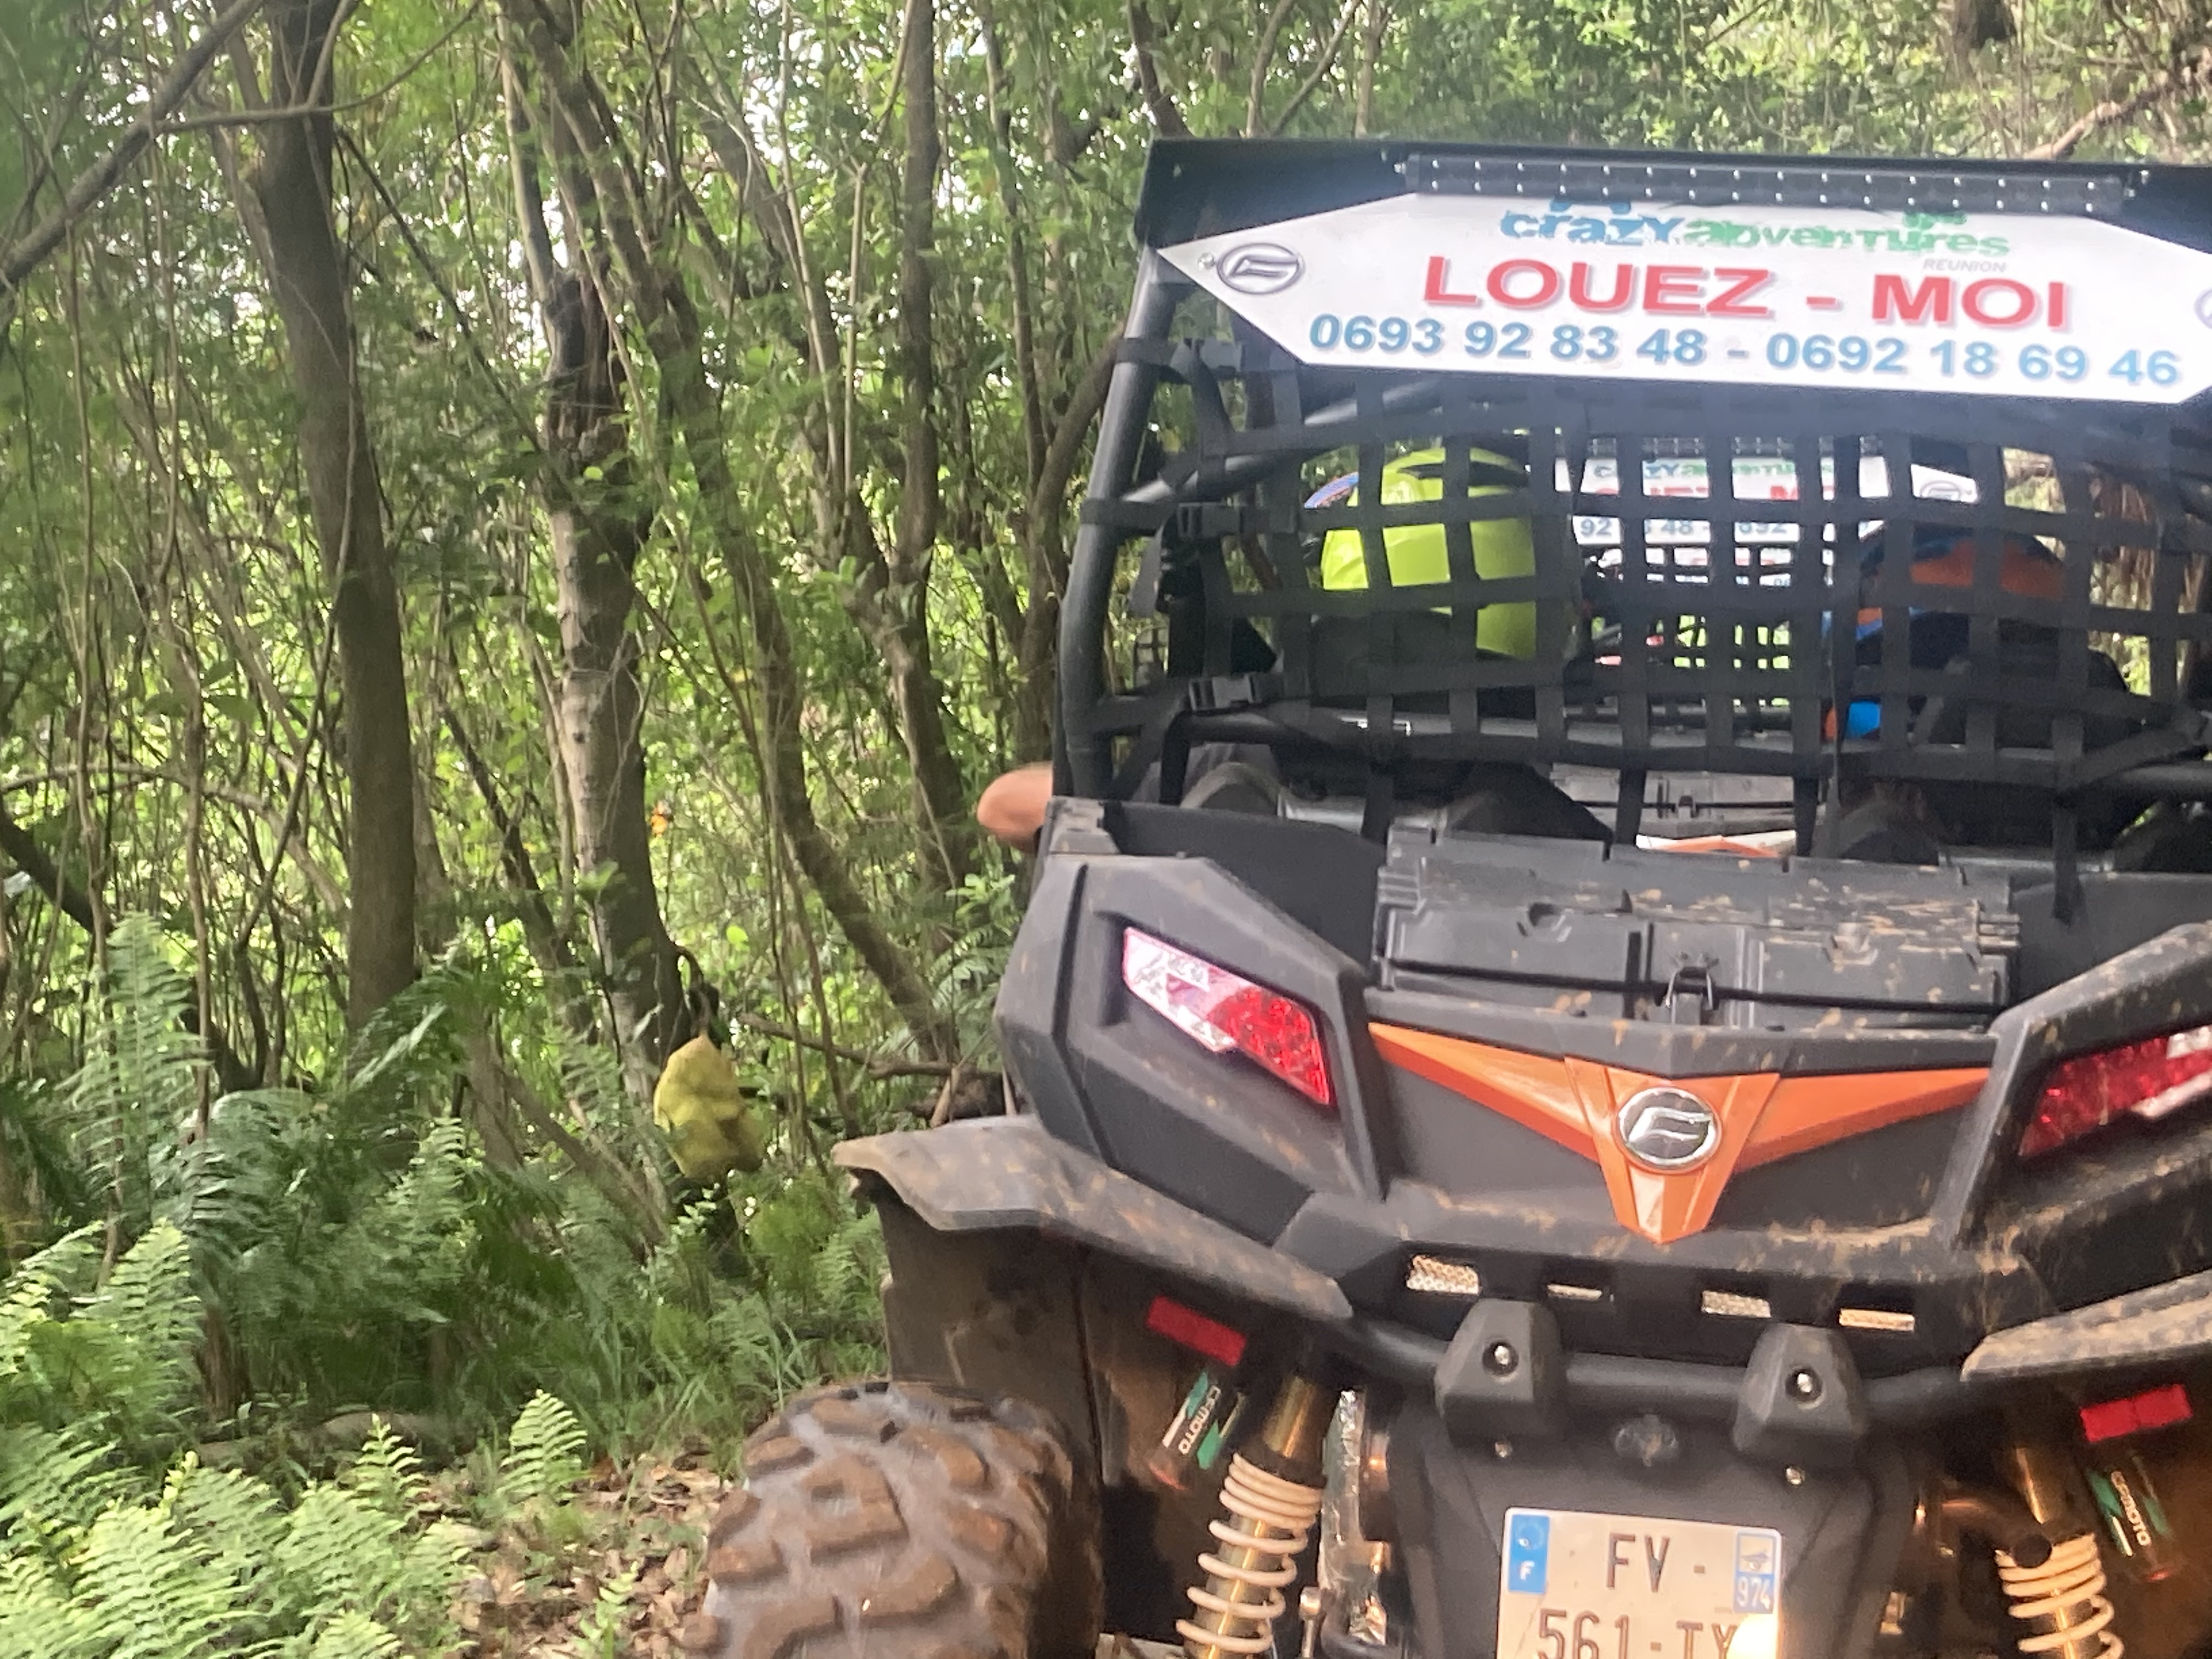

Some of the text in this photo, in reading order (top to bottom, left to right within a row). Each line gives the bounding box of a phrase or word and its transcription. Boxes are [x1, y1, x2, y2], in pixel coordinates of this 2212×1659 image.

[1424, 256, 1769, 316] LOUEZ
[1872, 274, 2065, 328] MOI
[1310, 314, 1442, 352] 0693
[1465, 321, 1531, 358] 92
[1551, 326, 1616, 360] 83
[1637, 328, 1706, 366] 48
[1767, 332, 1906, 373] 0692
[1930, 339, 1995, 376] 18
[2019, 345, 2087, 381] 69
[2109, 350, 2179, 385] 46
[1580, 517, 1612, 538] 92
[1520, 1561, 1534, 1579] F
[1737, 1576, 1770, 1609] 974
